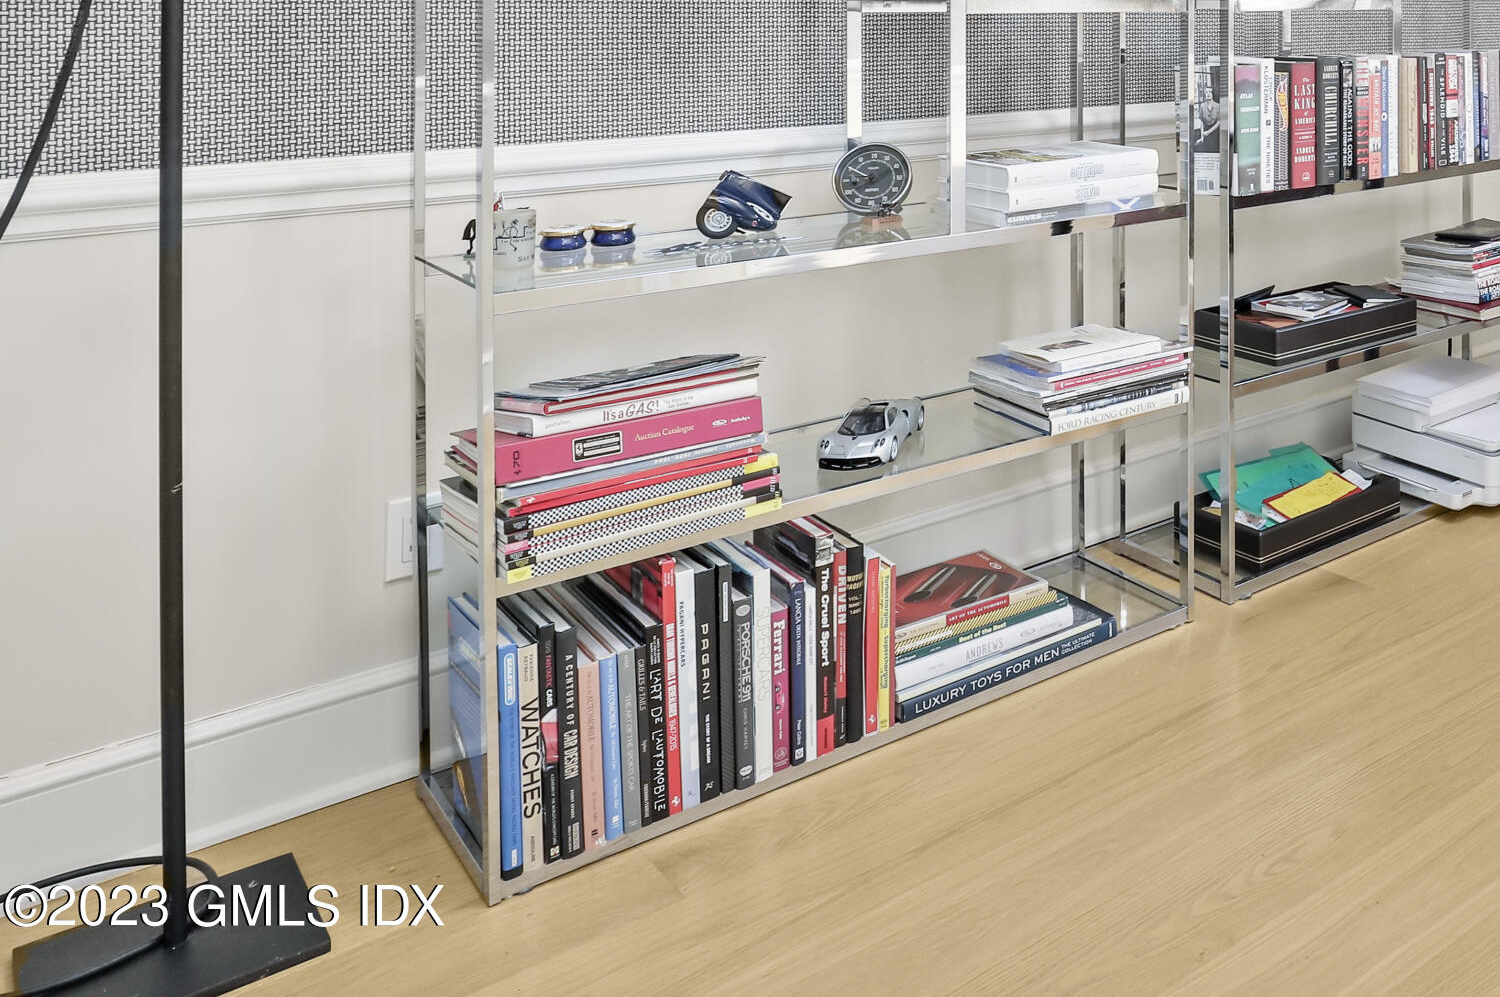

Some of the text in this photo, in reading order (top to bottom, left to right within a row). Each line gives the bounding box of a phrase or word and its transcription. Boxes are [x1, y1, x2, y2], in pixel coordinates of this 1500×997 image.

[1356, 59, 1369, 83] THE
[1294, 83, 1315, 96] LAST
[1294, 97, 1315, 110] KING
[1324, 85, 1338, 146] CHURCHILL
[1076, 186, 1100, 199] STELVIO
[1007, 213, 1042, 223] CURVES
[1478, 280, 1488, 289] THE
[1480, 287, 1490, 296] THE
[602, 410, 617, 422] It's
[625, 399, 660, 418] GAS!
[1058, 401, 1156, 432] FORD RACING CENTURY
[634, 425, 695, 442] Auction Catalogue
[838, 564, 847, 625] DRIVEN
[794, 597, 803, 624] LANCIA
[819, 568, 830, 667] The Cruel Sport
[949, 614, 959, 623] ART
[959, 612, 966, 620] OF
[967, 609, 977, 617] THE
[959, 621, 1007, 644] Best of the Best
[1060, 631, 1096, 650] THE ULTIMATE
[756, 605, 771, 703] SUPERCARS
[773, 618, 787, 676] Ferrari
[965, 637, 1004, 662] ANDREWS
[1060, 638, 1094, 655] COLLECTION
[637, 658, 645, 685] GRILLES
[701, 622, 711, 702] PAGANI
[741, 621, 751, 703] PORSCHE 911
[915, 647, 1060, 714] LUXURY TOYS FOR MEN
[608, 684, 616, 730] AUTOMOBILE
[639, 692, 647, 712] TAILS
[563, 654, 579, 780] A CENTURY OF CAR DESIGN
[625, 709, 633, 724] ART
[626, 724, 633, 736] OF
[649, 668, 666, 812] L'ART DE L'AUTOMOBILE
[669, 718, 678, 751] 1947-2015
[521, 697, 541, 819] WATCHES
